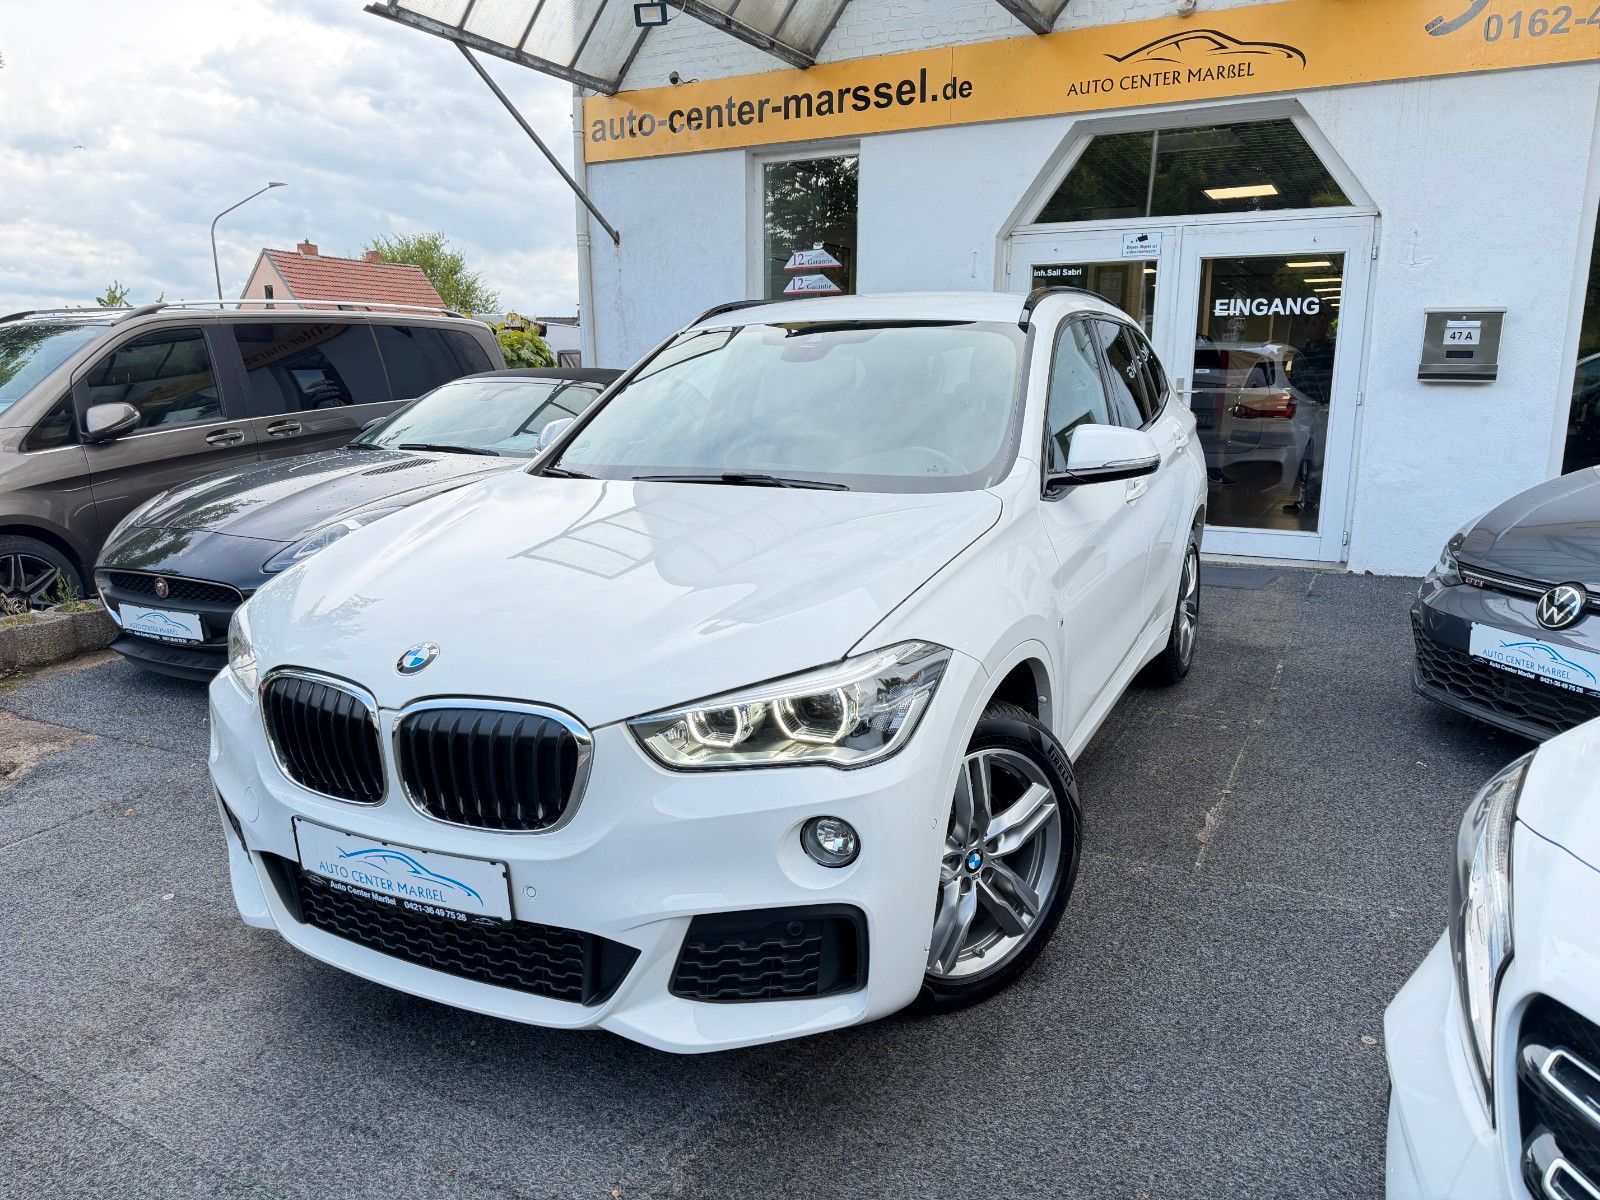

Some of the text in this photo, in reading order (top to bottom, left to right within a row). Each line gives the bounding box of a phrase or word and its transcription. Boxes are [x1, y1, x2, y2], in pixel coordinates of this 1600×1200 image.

[1483, 5, 1600, 42] 0162-4
[1066, 62, 1255, 97] AUTO CENTER MARßEL
[591, 68, 973, 143] auto-center-marssel.de
[792, 253, 805, 266] 12
[1062, 268, 1082, 276] Sabri
[791, 277, 804, 291] 12
[1214, 296, 1320, 317] EINGANG
[1449, 331, 1473, 340] 47 A
[1482, 648, 1504, 661] AUTO
[1505, 655, 1535, 671] CENTER
[320, 860, 349, 878] AUTO
[351, 870, 394, 892] CENTER
[330, 880, 347, 892] Auto
[347, 885, 371, 898] Center
[446, 911, 456, 919] 75
